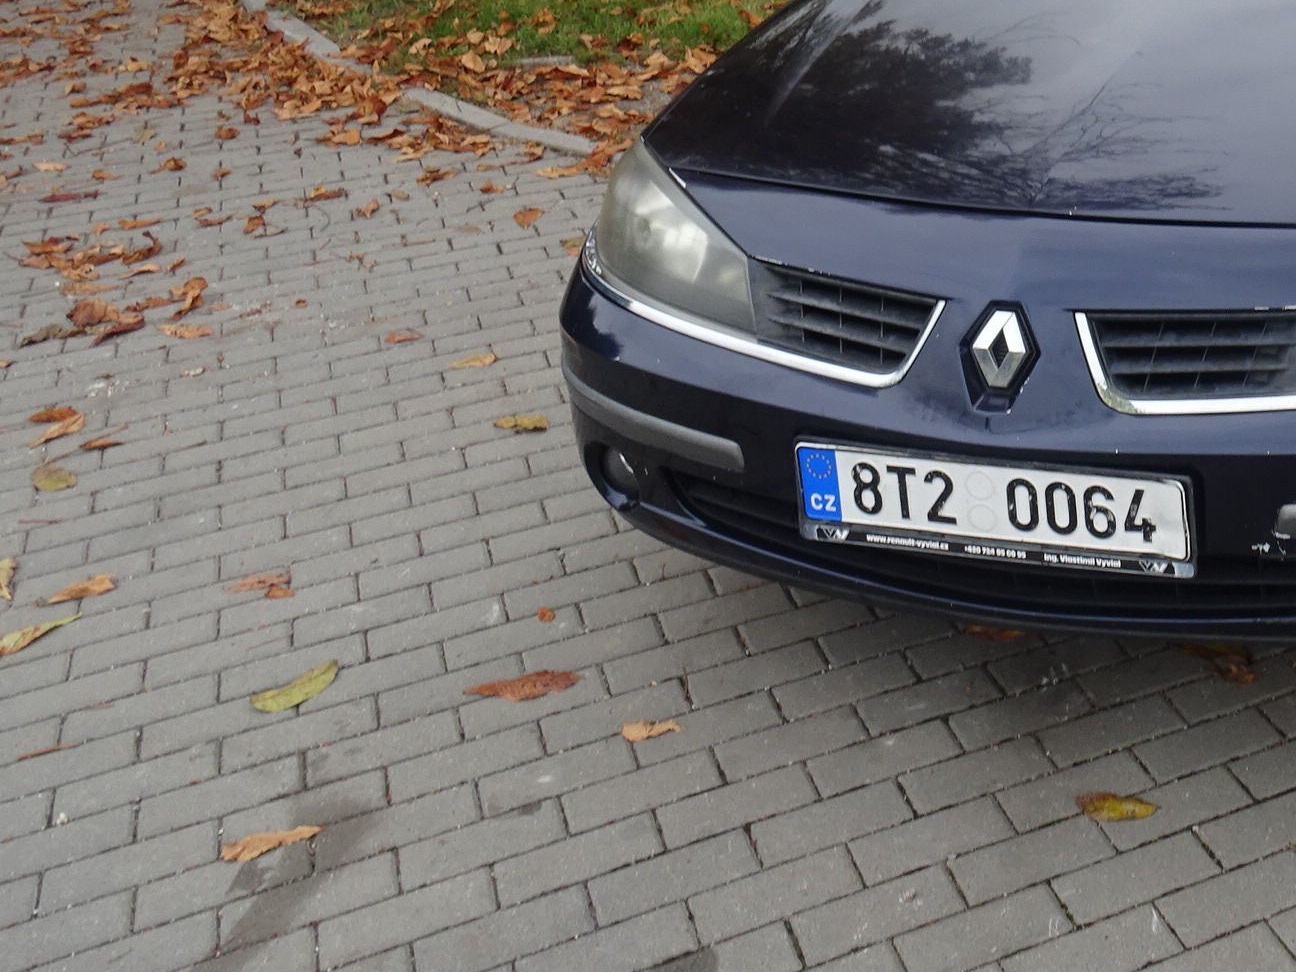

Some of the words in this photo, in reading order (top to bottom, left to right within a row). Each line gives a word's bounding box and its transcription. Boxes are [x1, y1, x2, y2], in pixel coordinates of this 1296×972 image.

[811, 493, 837, 512] CZ
[851, 462, 957, 525] 8T2
[1006, 477, 1157, 543] 0064
